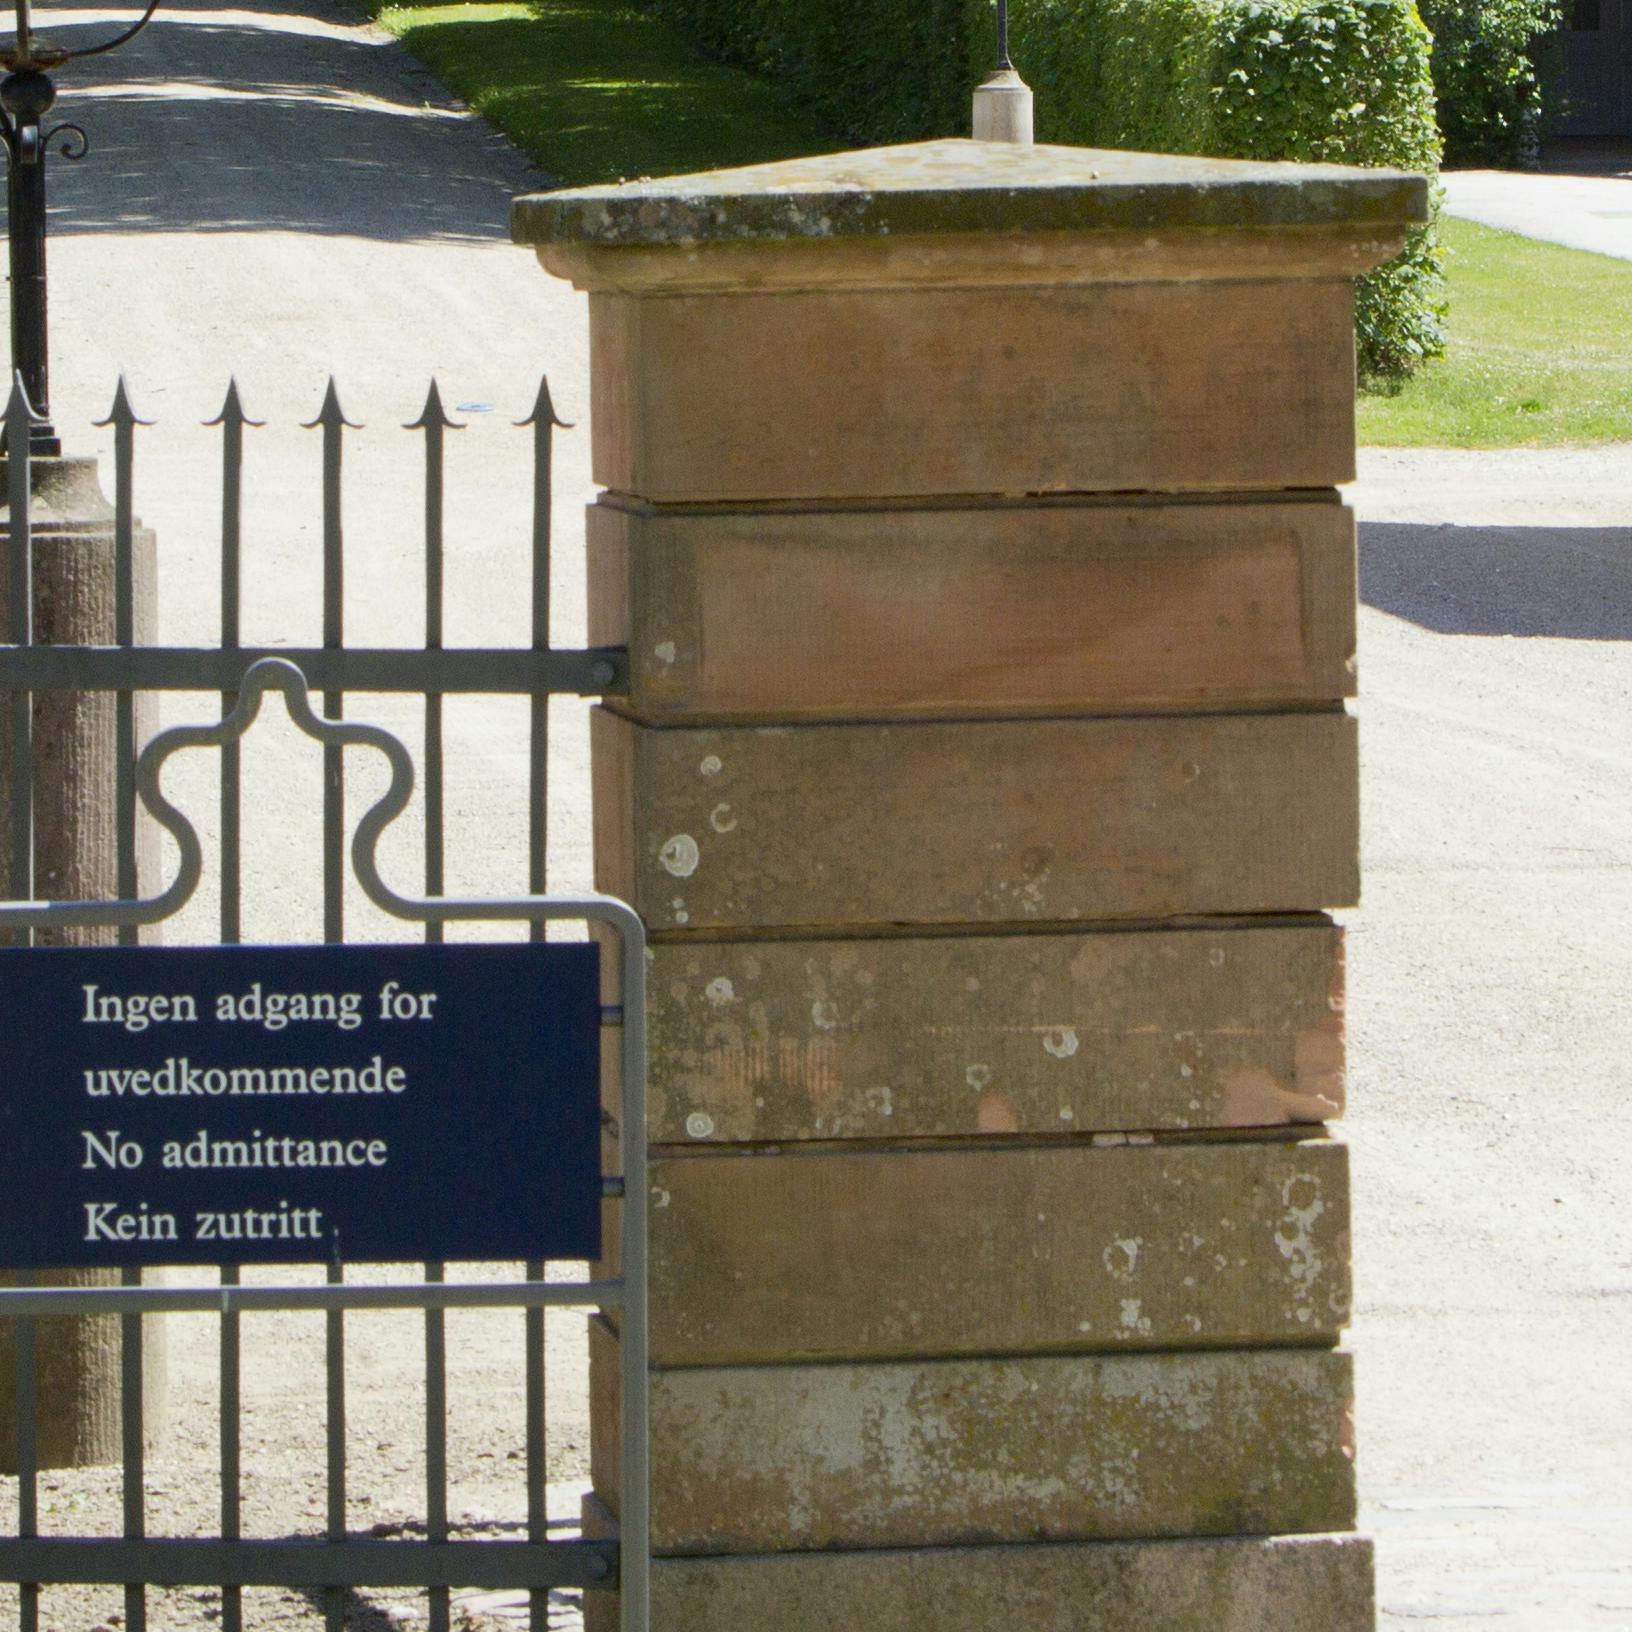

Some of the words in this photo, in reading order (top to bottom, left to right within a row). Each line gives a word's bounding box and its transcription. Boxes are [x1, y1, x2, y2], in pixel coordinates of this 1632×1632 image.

[82, 984, 198, 1032] Ingen
[215, 982, 362, 1031] adgang
[379, 981, 438, 1020] for
[83, 1055, 406, 1097] uvedkommende
[81, 1130, 144, 1169] No
[162, 1129, 387, 1169] admittance
[83, 1202, 179, 1241] Kein
[195, 1200, 323, 1240] zutritt
